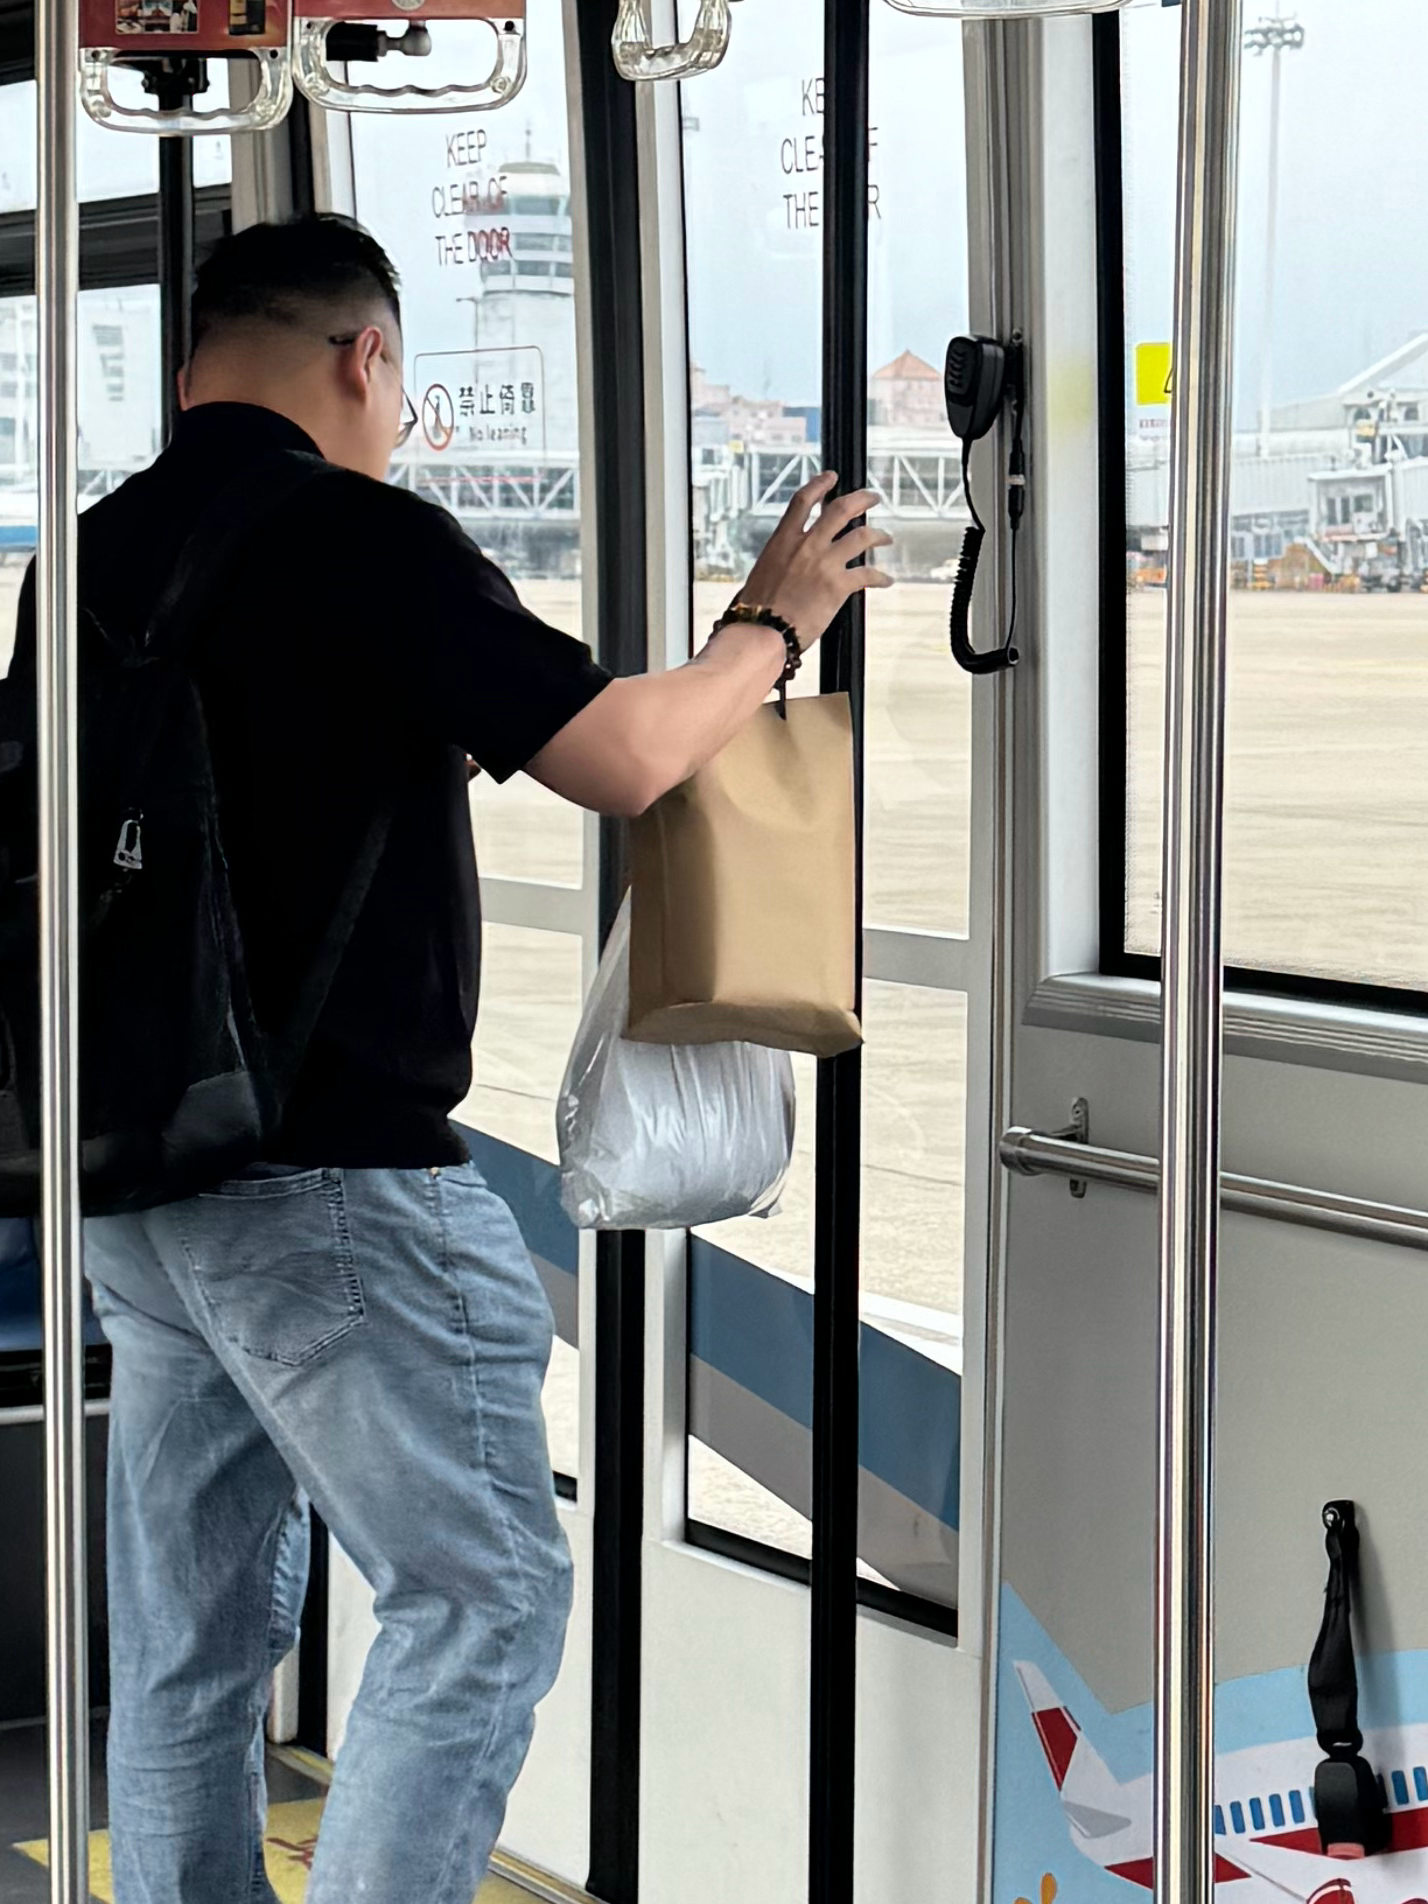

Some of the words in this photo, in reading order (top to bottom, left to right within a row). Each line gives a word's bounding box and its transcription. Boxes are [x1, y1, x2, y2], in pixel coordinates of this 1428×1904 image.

[801, 76, 825, 117] KE
[445, 128, 487, 169] KEEP
[780, 135, 825, 175] CLE
[431, 180, 480, 219] CLEAR
[487, 175, 508, 214] OF
[782, 190, 820, 230] THE
[434, 232, 464, 267] THE
[467, 225, 514, 264] DOOR
[458, 382, 536, 417] 禁止倚靠
